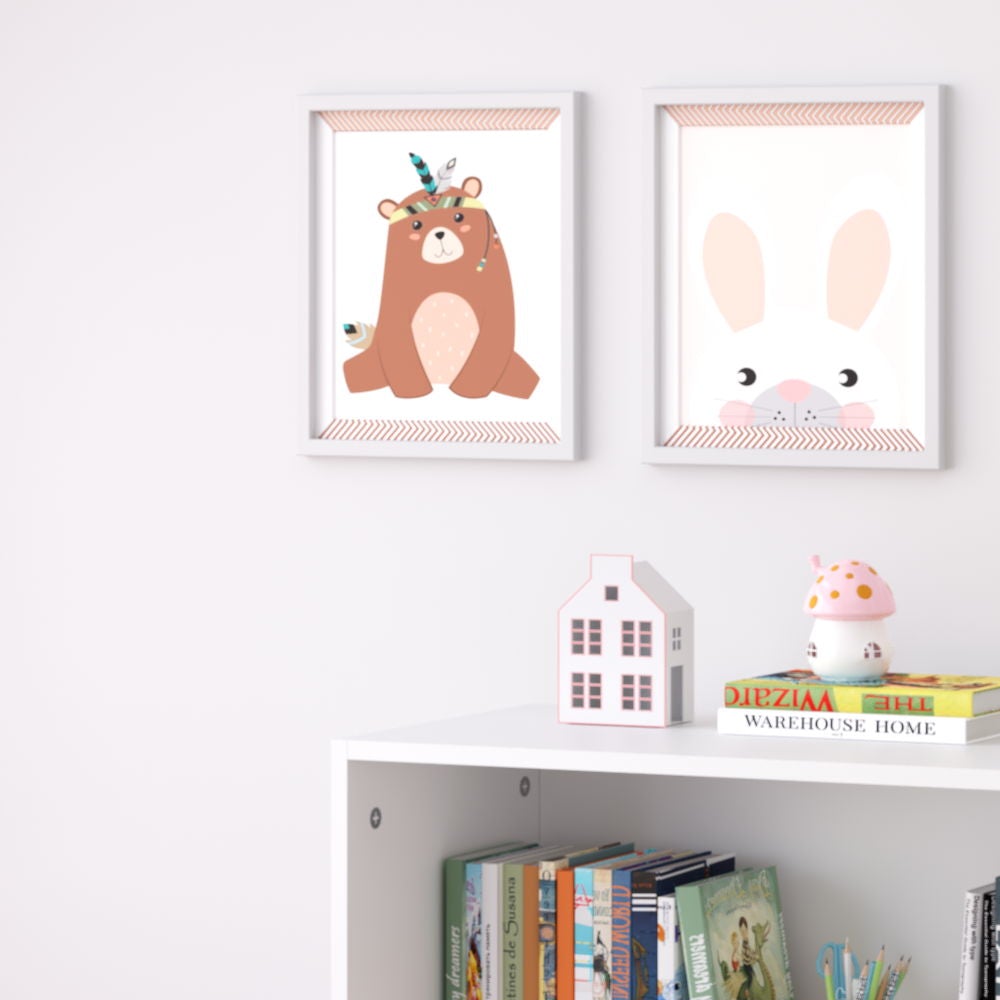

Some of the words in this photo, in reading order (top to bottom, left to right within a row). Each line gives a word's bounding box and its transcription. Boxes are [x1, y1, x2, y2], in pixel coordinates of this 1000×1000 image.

[864, 695, 932, 711] THE
[744, 714, 866, 732] WAREHOUSE
[875, 719, 936, 736] HOME
[503, 876, 519, 937] Susana
[446, 925, 461, 987] dreamers
[503, 940, 517, 959] de
